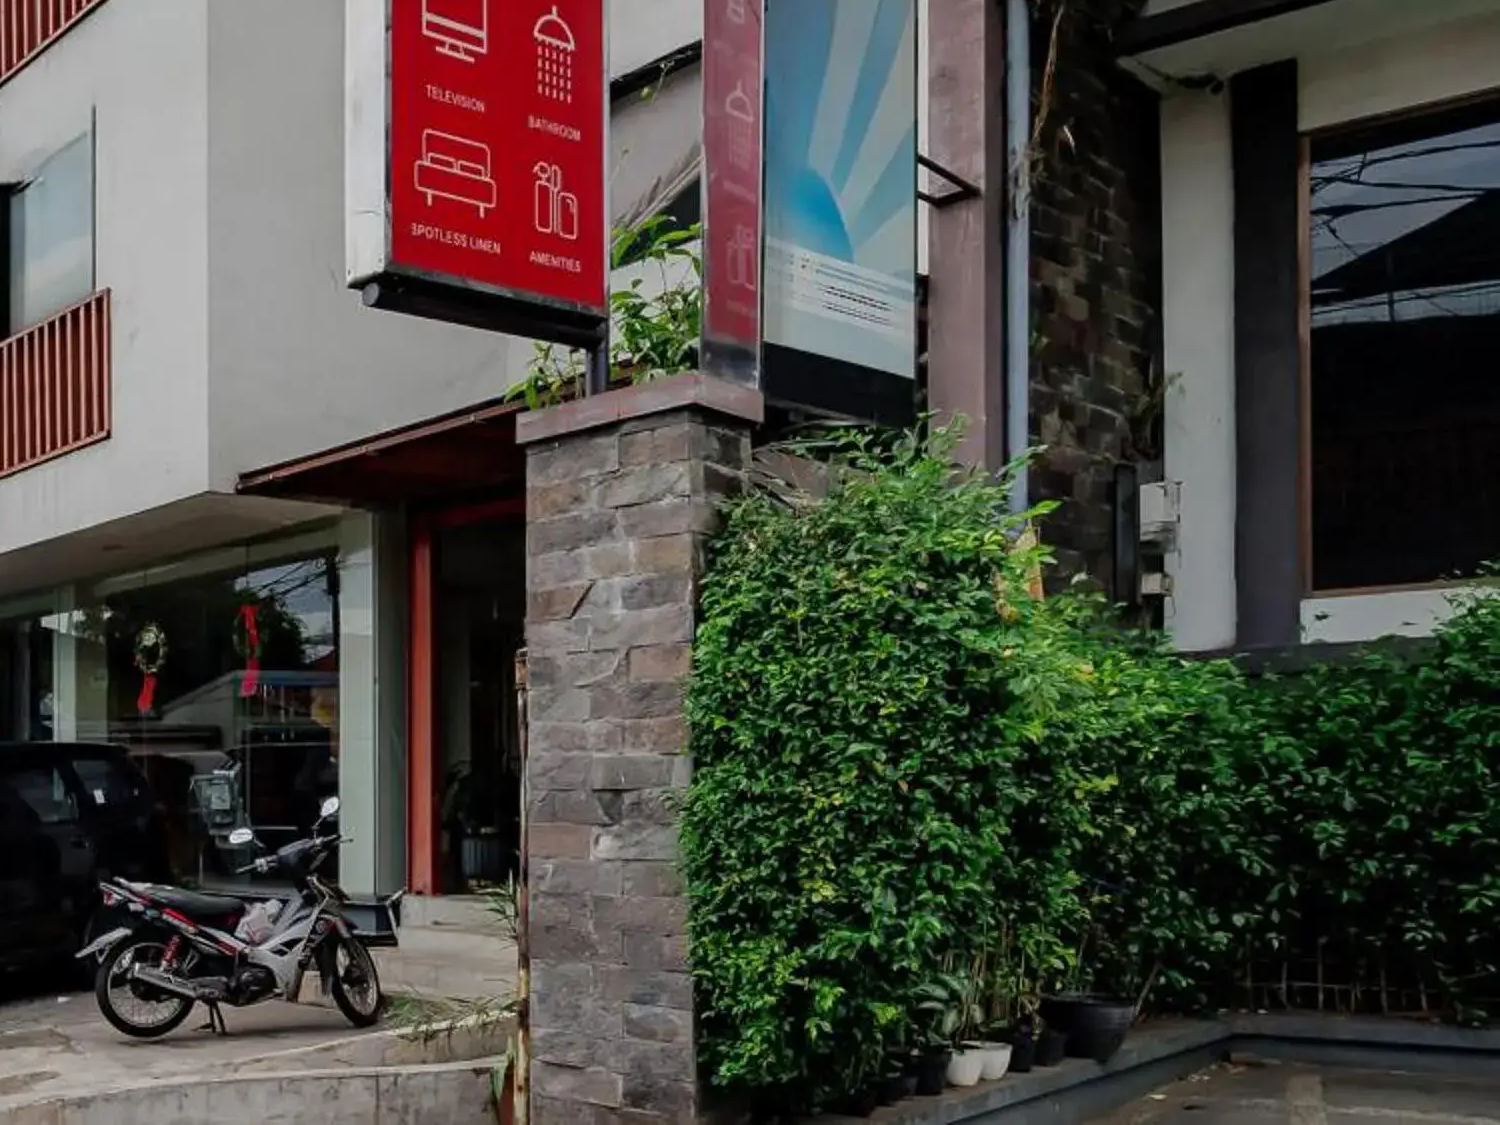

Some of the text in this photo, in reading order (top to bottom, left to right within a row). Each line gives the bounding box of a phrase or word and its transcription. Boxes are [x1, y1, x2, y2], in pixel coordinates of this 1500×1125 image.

[425, 84, 485, 113] TELEVISION
[527, 115, 582, 142] BATHROOM
[411, 222, 501, 256] SPOTLESS LINEN
[528, 250, 582, 273] AMENITIES
